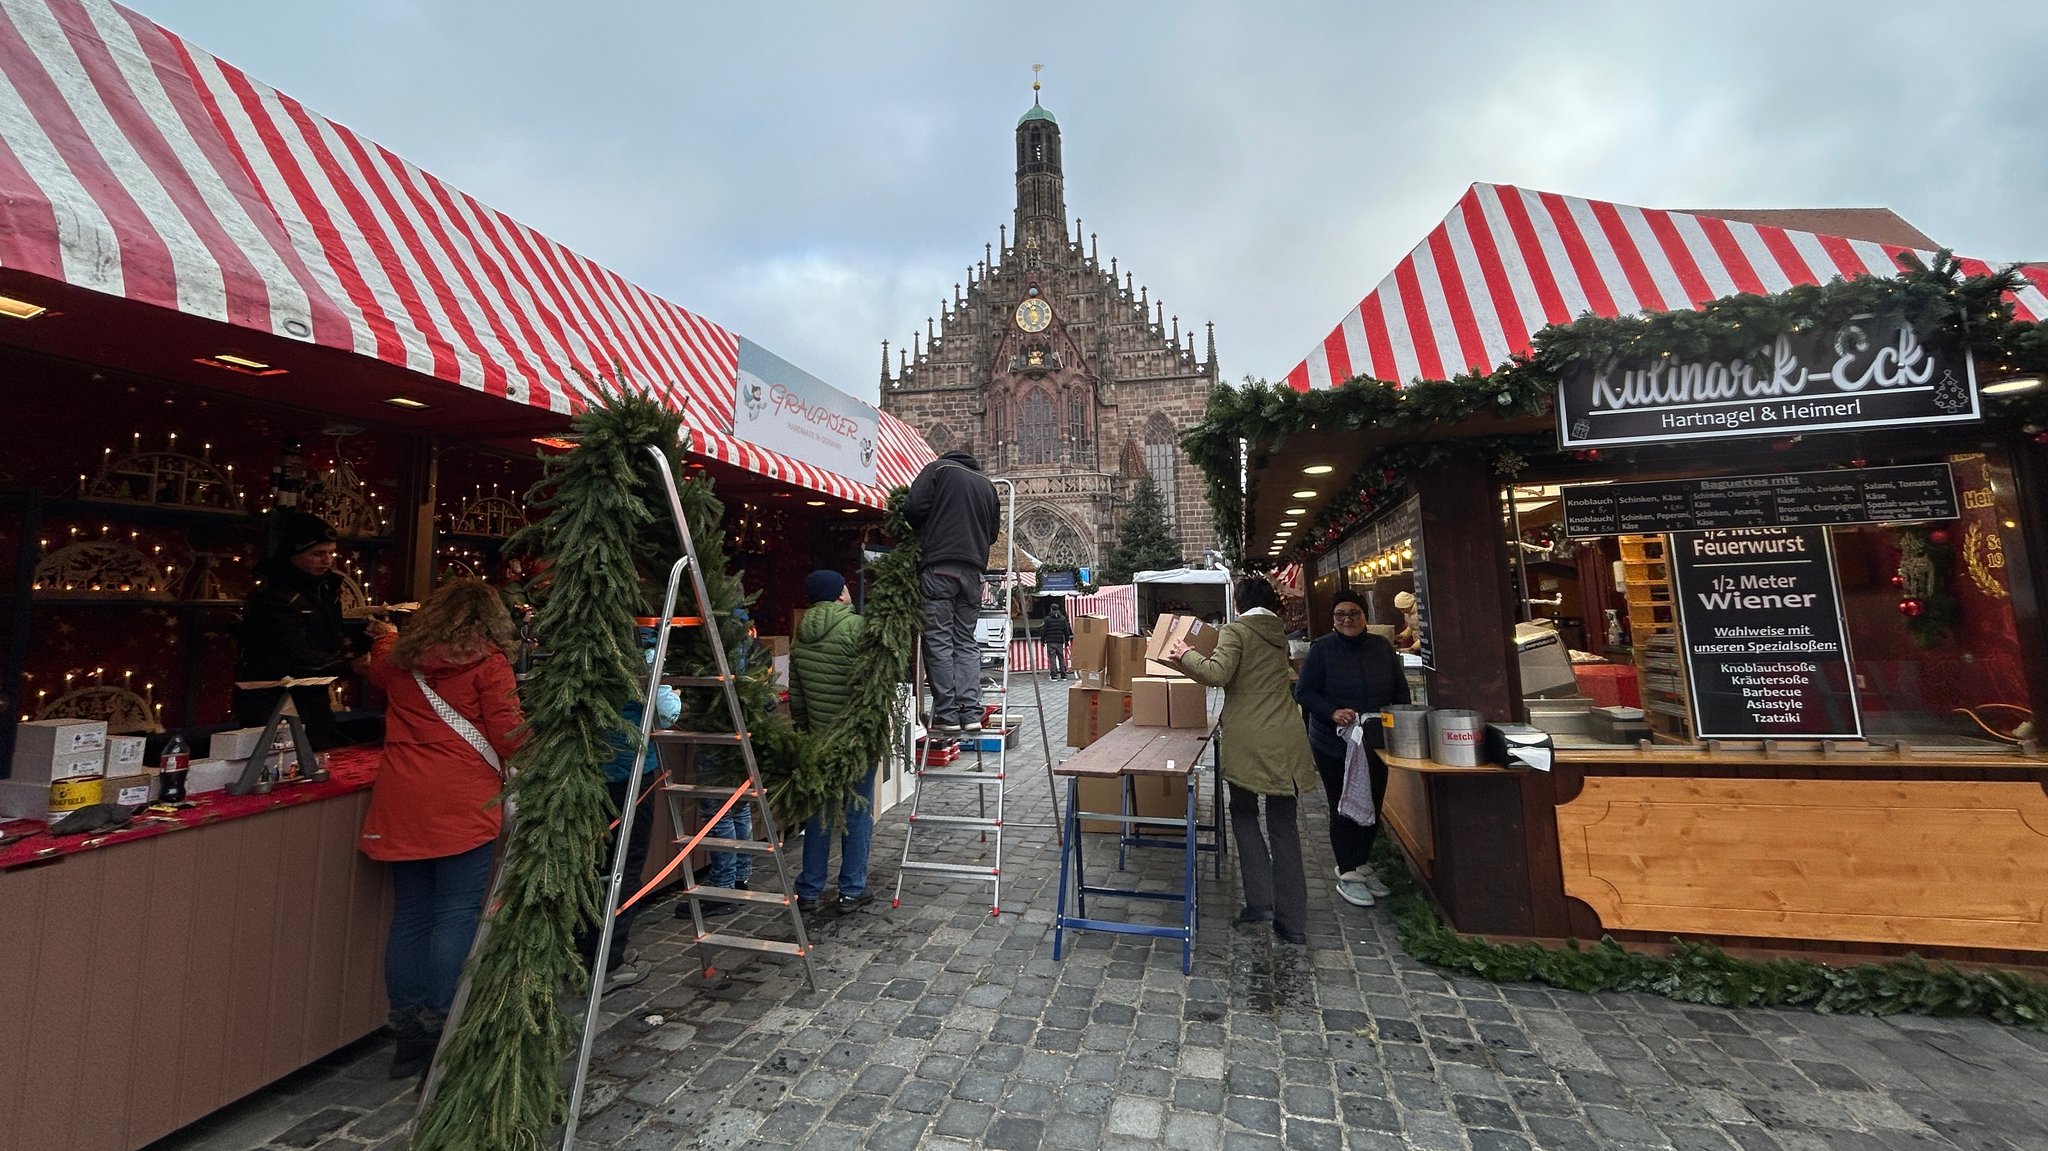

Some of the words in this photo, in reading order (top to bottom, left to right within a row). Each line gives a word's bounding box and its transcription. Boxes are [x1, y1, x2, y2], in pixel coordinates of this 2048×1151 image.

[769, 383, 858, 440] GRAUPNER
[1661, 407, 1755, 428] Hartnagel
[1761, 406, 1777, 421] &
[1782, 399, 1861, 420] Heimerl
[1701, 478, 1768, 489] Baguettes
[1771, 476, 1799, 484] mit:
[1864, 481, 1896, 490] Salami,
[1898, 479, 1938, 488] Tomaten
[1727, 490, 1771, 498] Champignon
[1775, 486, 1816, 495] Thunfisch,
[1817, 484, 1856, 493] Zwiebeln,
[1619, 496, 1659, 504] Schinken,
[1865, 492, 1887, 500] Käse
[1567, 498, 1613, 506] Knoblauch
[1867, 500, 1898, 509] Spezial:
[1778, 505, 1812, 513] Broccoli,
[1813, 503, 1862, 512] Champignon
[1656, 511, 1691, 519] Peperoni,
[1695, 510, 1731, 518] Schinken,
[1569, 515, 1614, 524] Knoblauch/
[1693, 535, 1805, 556] Feuerwurst
[1711, 575, 1736, 593] 1/2
[1740, 574, 1797, 589] Meter
[1697, 591, 1817, 610] Wiener
[1714, 626, 1785, 637] Wahlweise
[1788, 624, 1811, 635] mit
[1694, 642, 1745, 653] unseren
[1748, 640, 1837, 654] Spezialsoßen:
[1721, 662, 1817, 673] Knoblauchsoße
[1732, 675, 1809, 685] Kräutersoße
[1742, 687, 1802, 697] Barbecue
[1746, 699, 1803, 712] Asiastyle
[1752, 713, 1801, 723] Tzatziki
